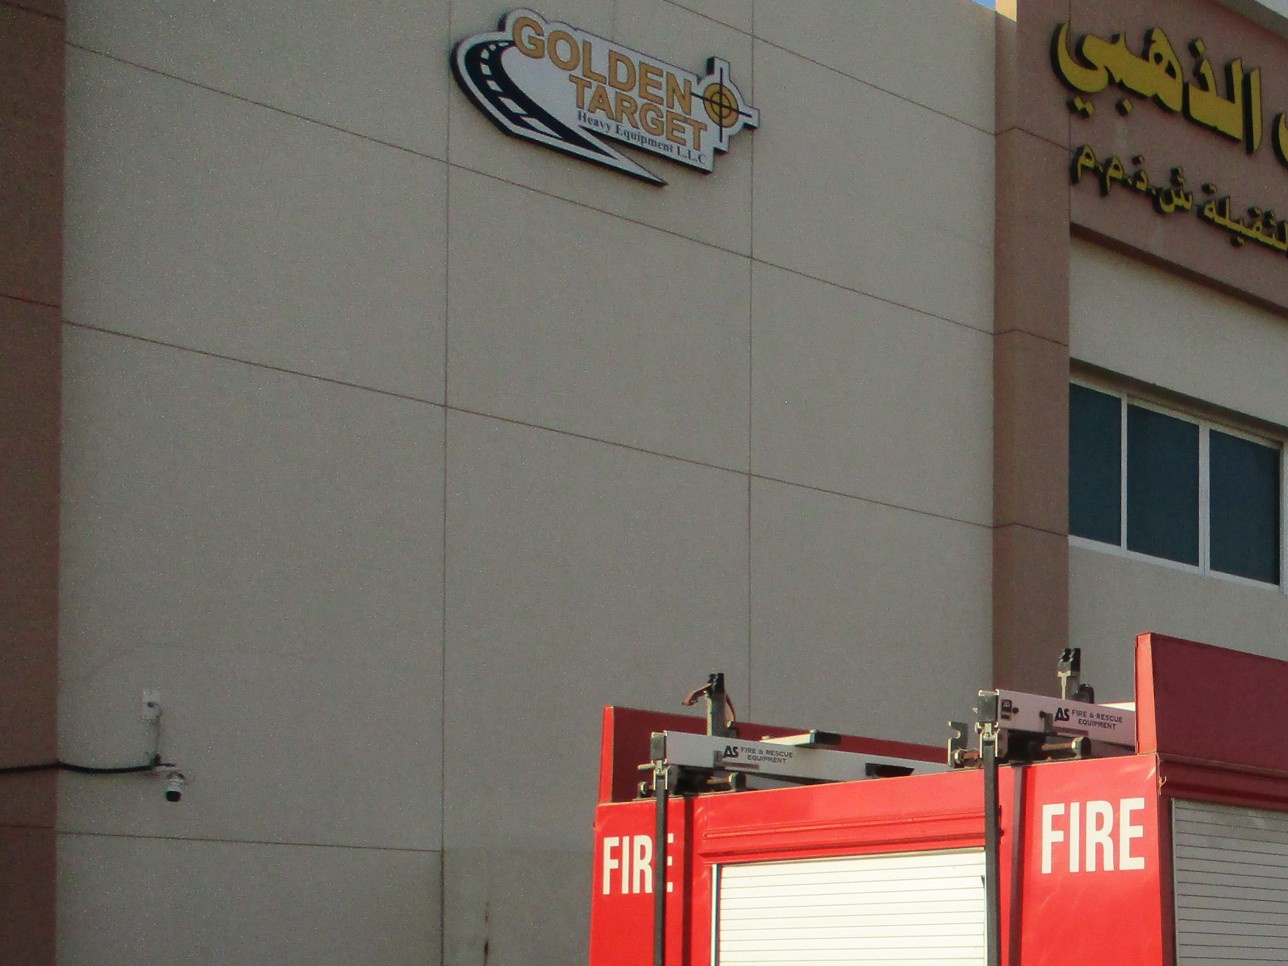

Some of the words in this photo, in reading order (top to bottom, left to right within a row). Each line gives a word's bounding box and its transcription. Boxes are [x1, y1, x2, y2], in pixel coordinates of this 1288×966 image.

[512, 16, 693, 116] GOLDEN
[1051, 20, 1263, 154] الذهبي
[568, 74, 708, 151] TARGET
[577, 109, 611, 134] Heavy
[615, 124, 673, 154] Equipment
[1071, 709, 1087, 718] FIRE
[1096, 713, 1123, 723] RESCUE
[1078, 718, 1117, 730] EQUIPMENT
[741, 746, 757, 755] FIRE
[766, 749, 793, 758] RESCUE
[747, 754, 787, 764] EQUIPMENT
[1041, 798, 1145, 874] FIRE
